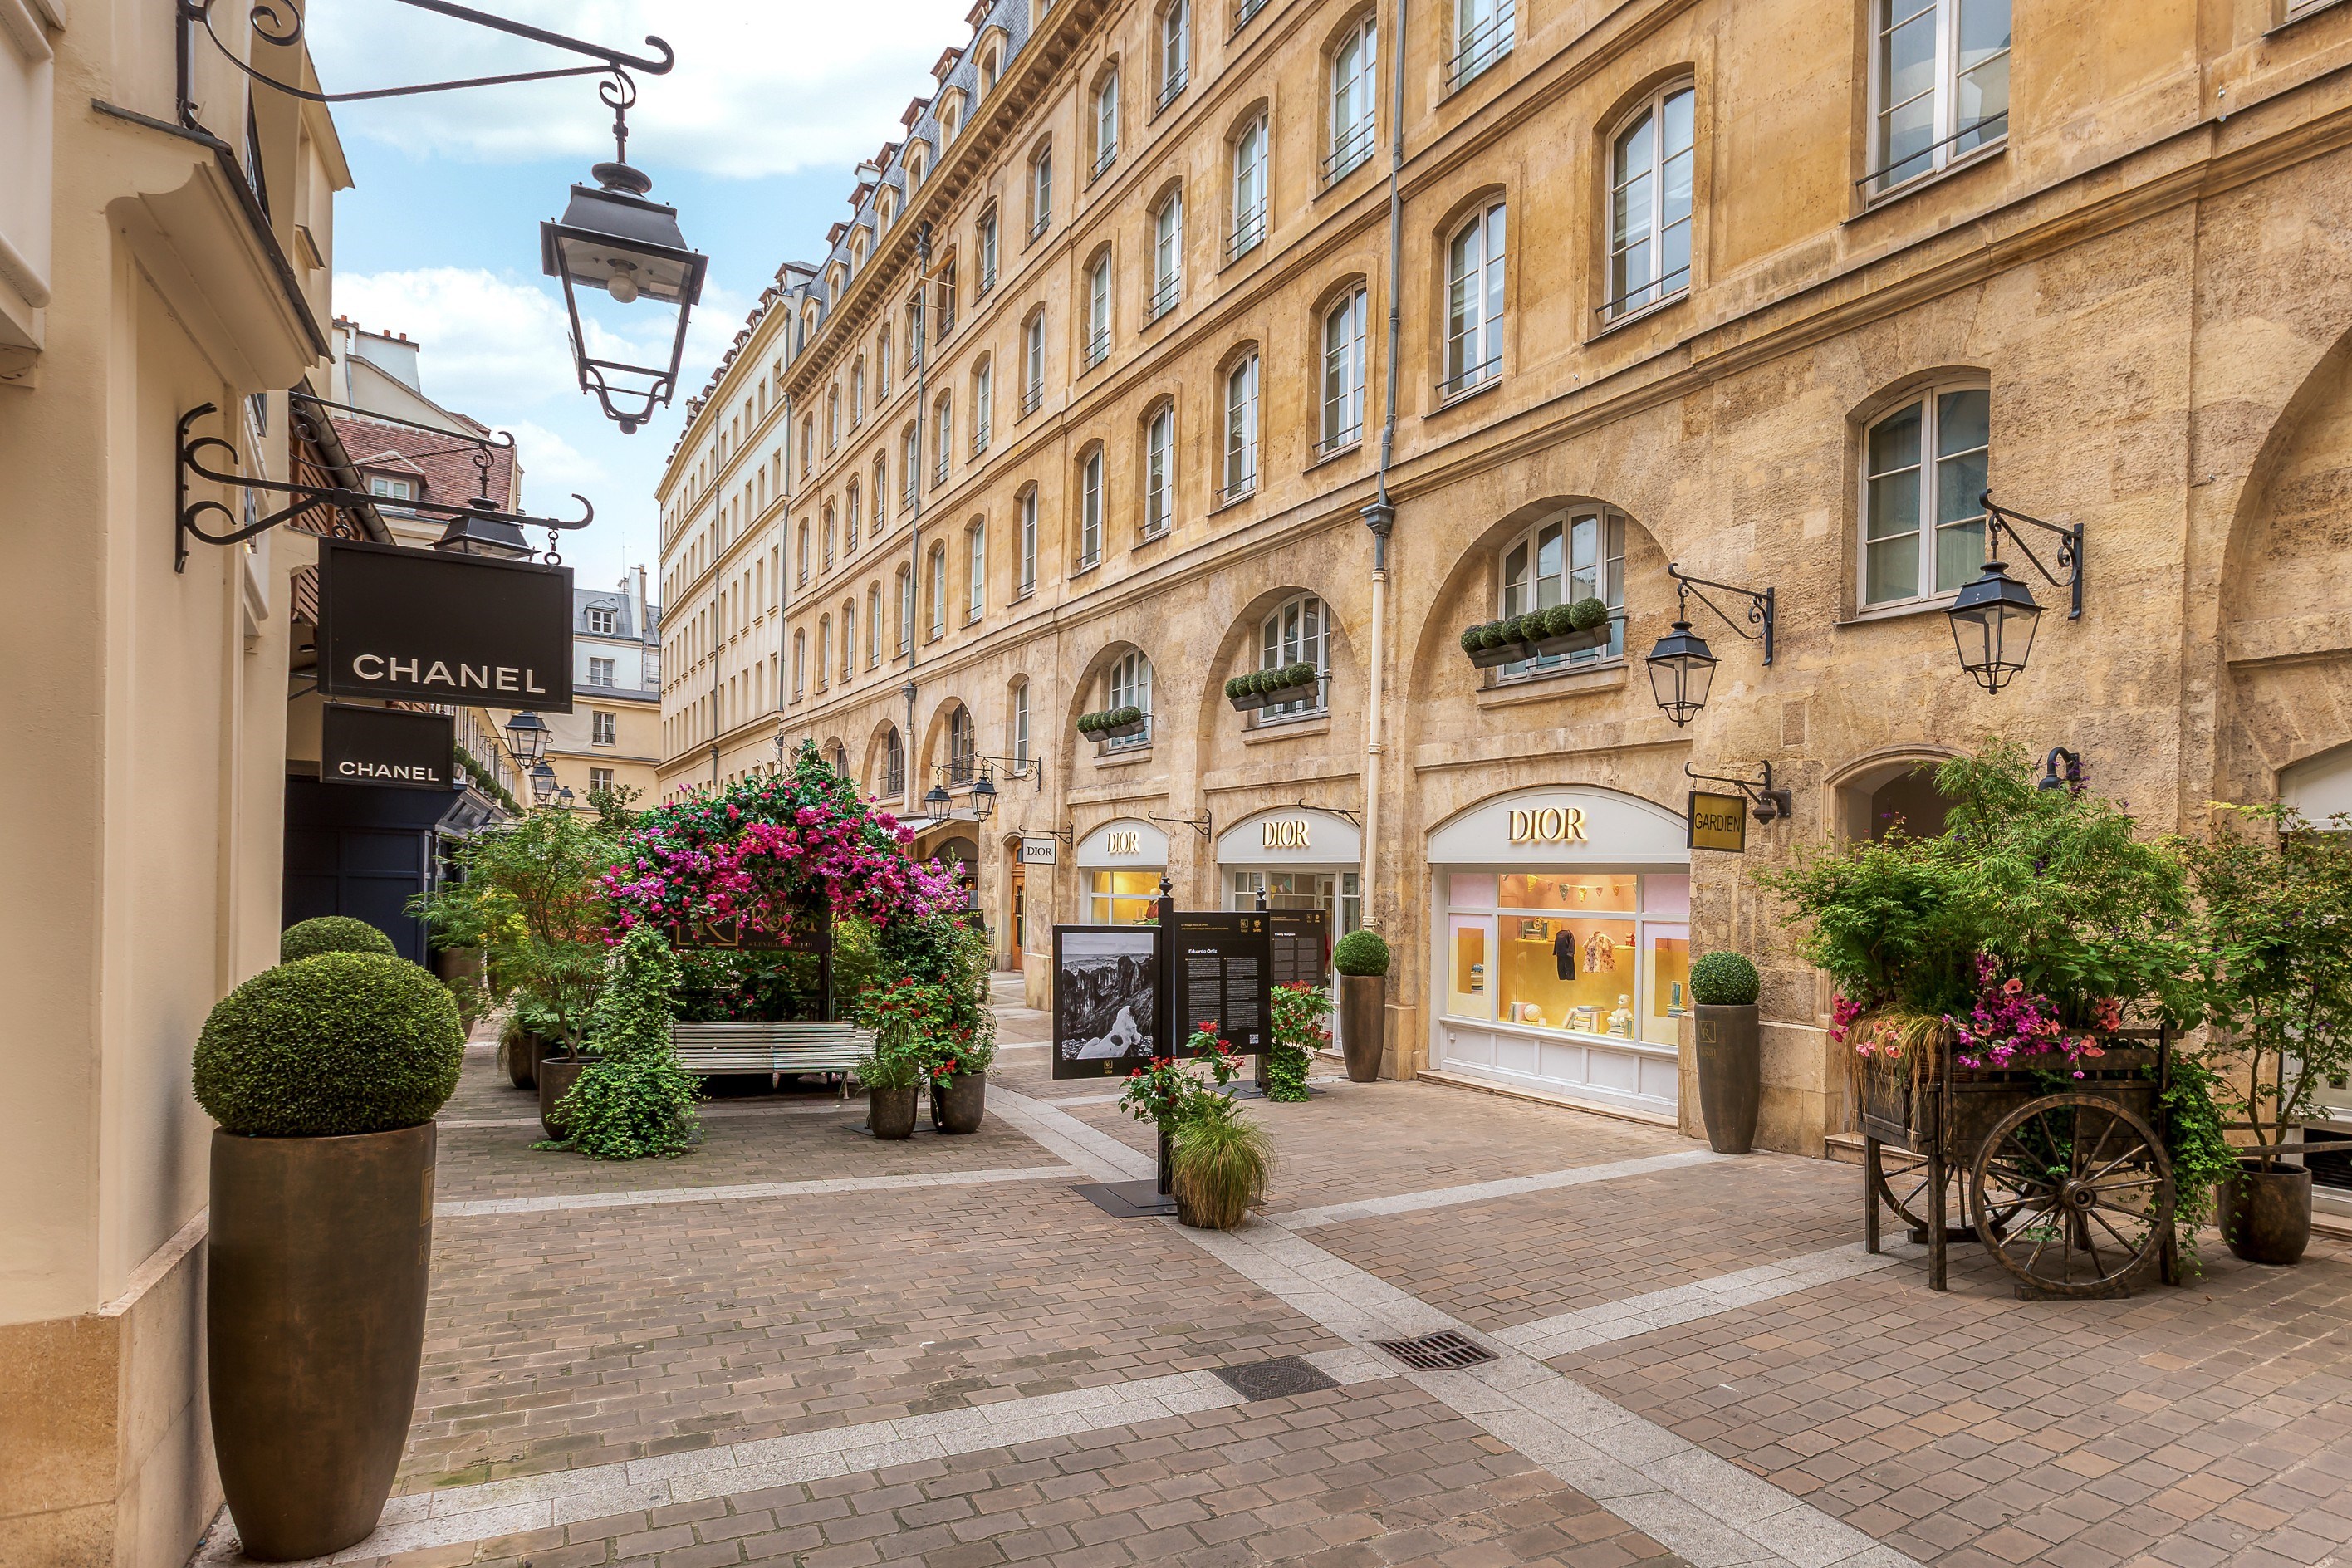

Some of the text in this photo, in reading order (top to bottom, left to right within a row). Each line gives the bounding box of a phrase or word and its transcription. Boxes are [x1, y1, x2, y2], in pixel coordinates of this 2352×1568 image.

[353, 654, 546, 694] CHANEL
[339, 762, 439, 782] CHANEL
[1262, 820, 1310, 846] DIOR
[1507, 807, 1586, 840] DIOR
[1694, 812, 1741, 833] GARDIEN
[1027, 846, 1052, 856] DIOR
[1107, 831, 1139, 852] DIOR
